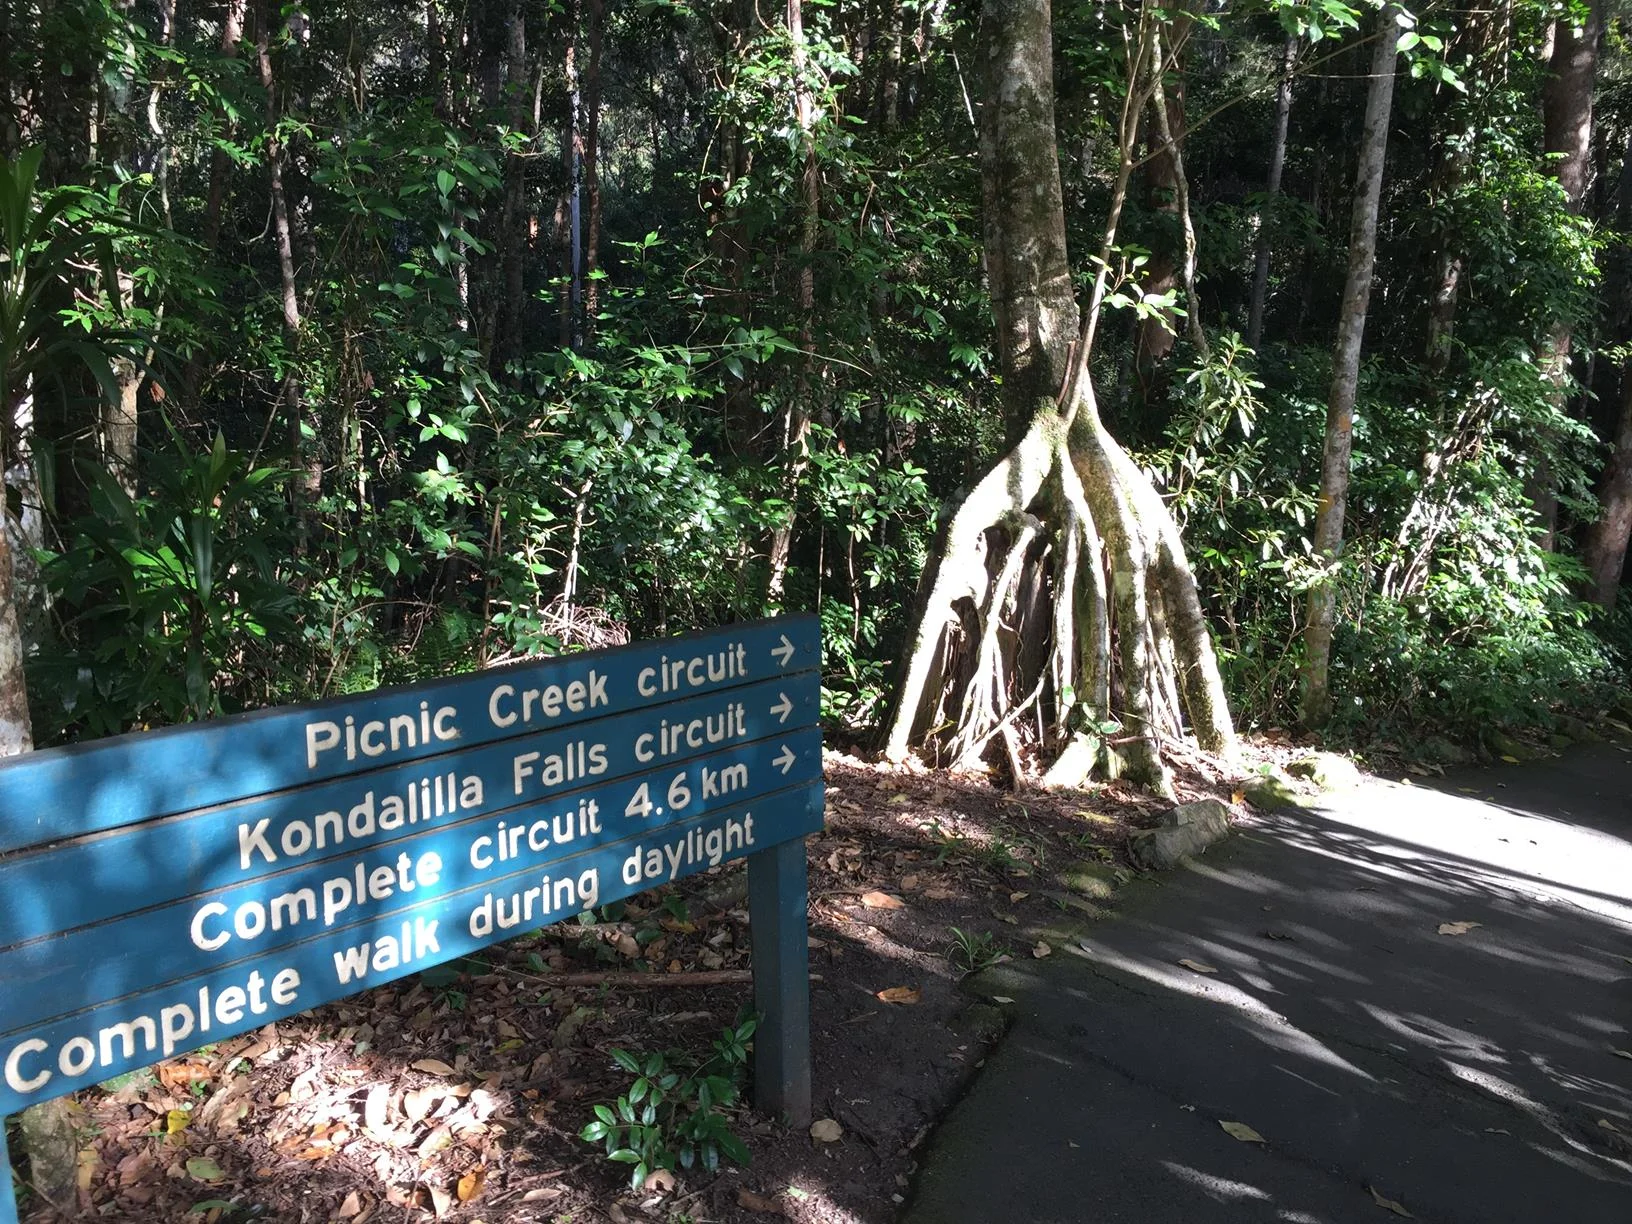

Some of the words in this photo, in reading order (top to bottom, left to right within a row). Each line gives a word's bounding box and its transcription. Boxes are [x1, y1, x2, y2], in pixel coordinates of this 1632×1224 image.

[238, 773, 483, 870] Kondalilla
[513, 740, 608, 795] Falls
[634, 703, 746, 763] circuit
[306, 701, 458, 768] Picnic
[489, 669, 609, 728] Creek
[637, 643, 747, 697] circuit
[190, 850, 441, 951] Complete
[470, 799, 602, 869] circuit
[625, 771, 692, 818] 4.6
[702, 761, 748, 800] km
[4, 966, 301, 1094] Complete
[333, 916, 440, 985] walk
[469, 873, 599, 939] during
[622, 812, 756, 886] daylight
